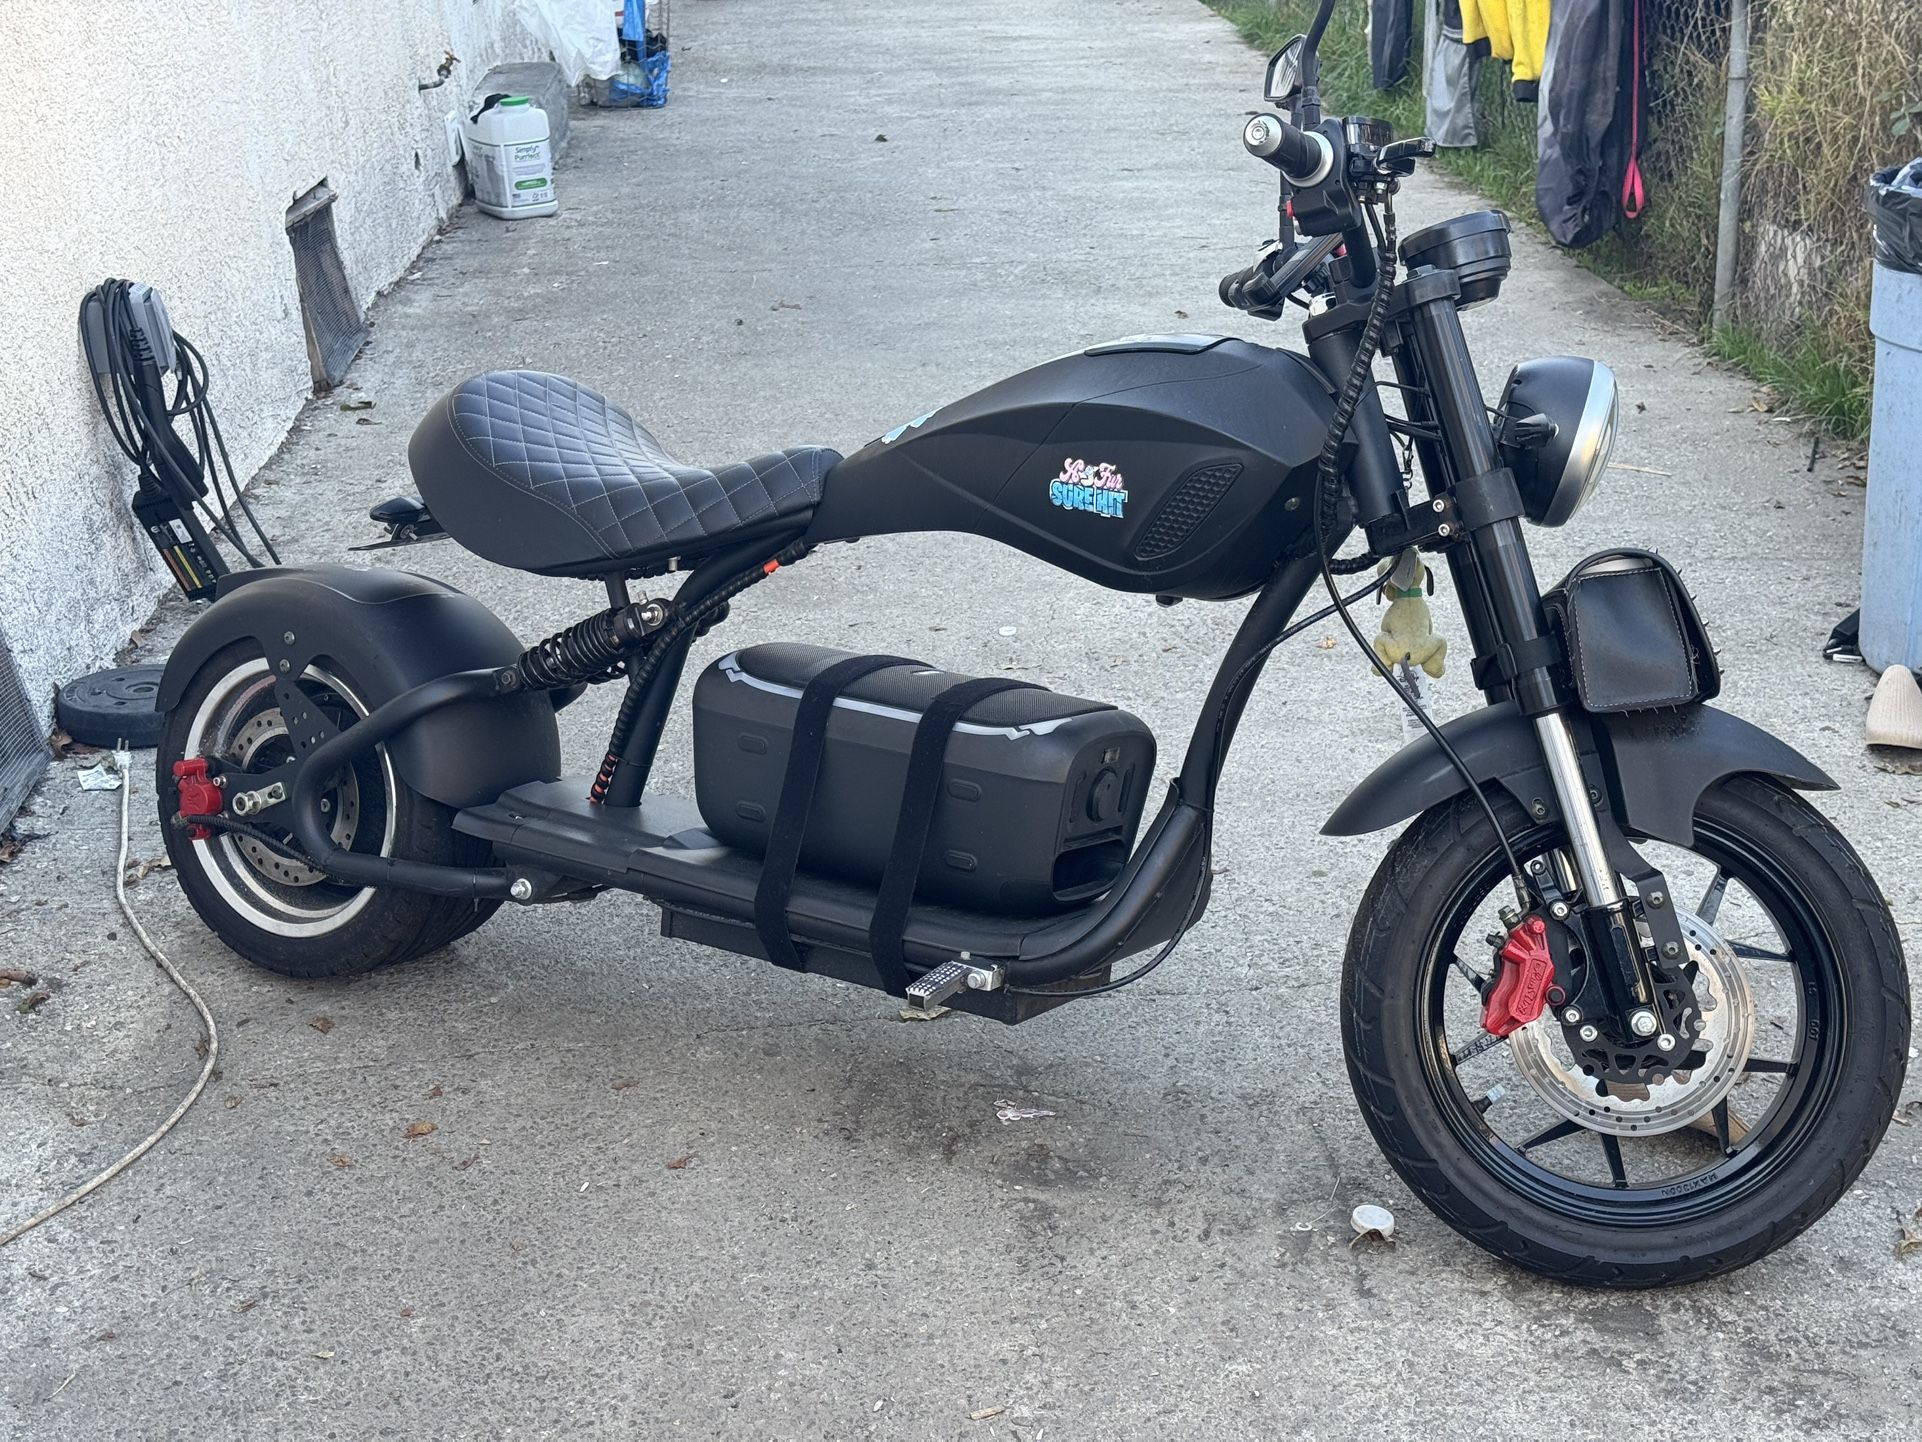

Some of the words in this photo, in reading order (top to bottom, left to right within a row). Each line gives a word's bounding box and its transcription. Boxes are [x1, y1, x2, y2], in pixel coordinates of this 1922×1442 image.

[515, 145, 539, 154] Simply
[1051, 481, 1094, 512] SURE
[1095, 489, 1128, 518] HIT
